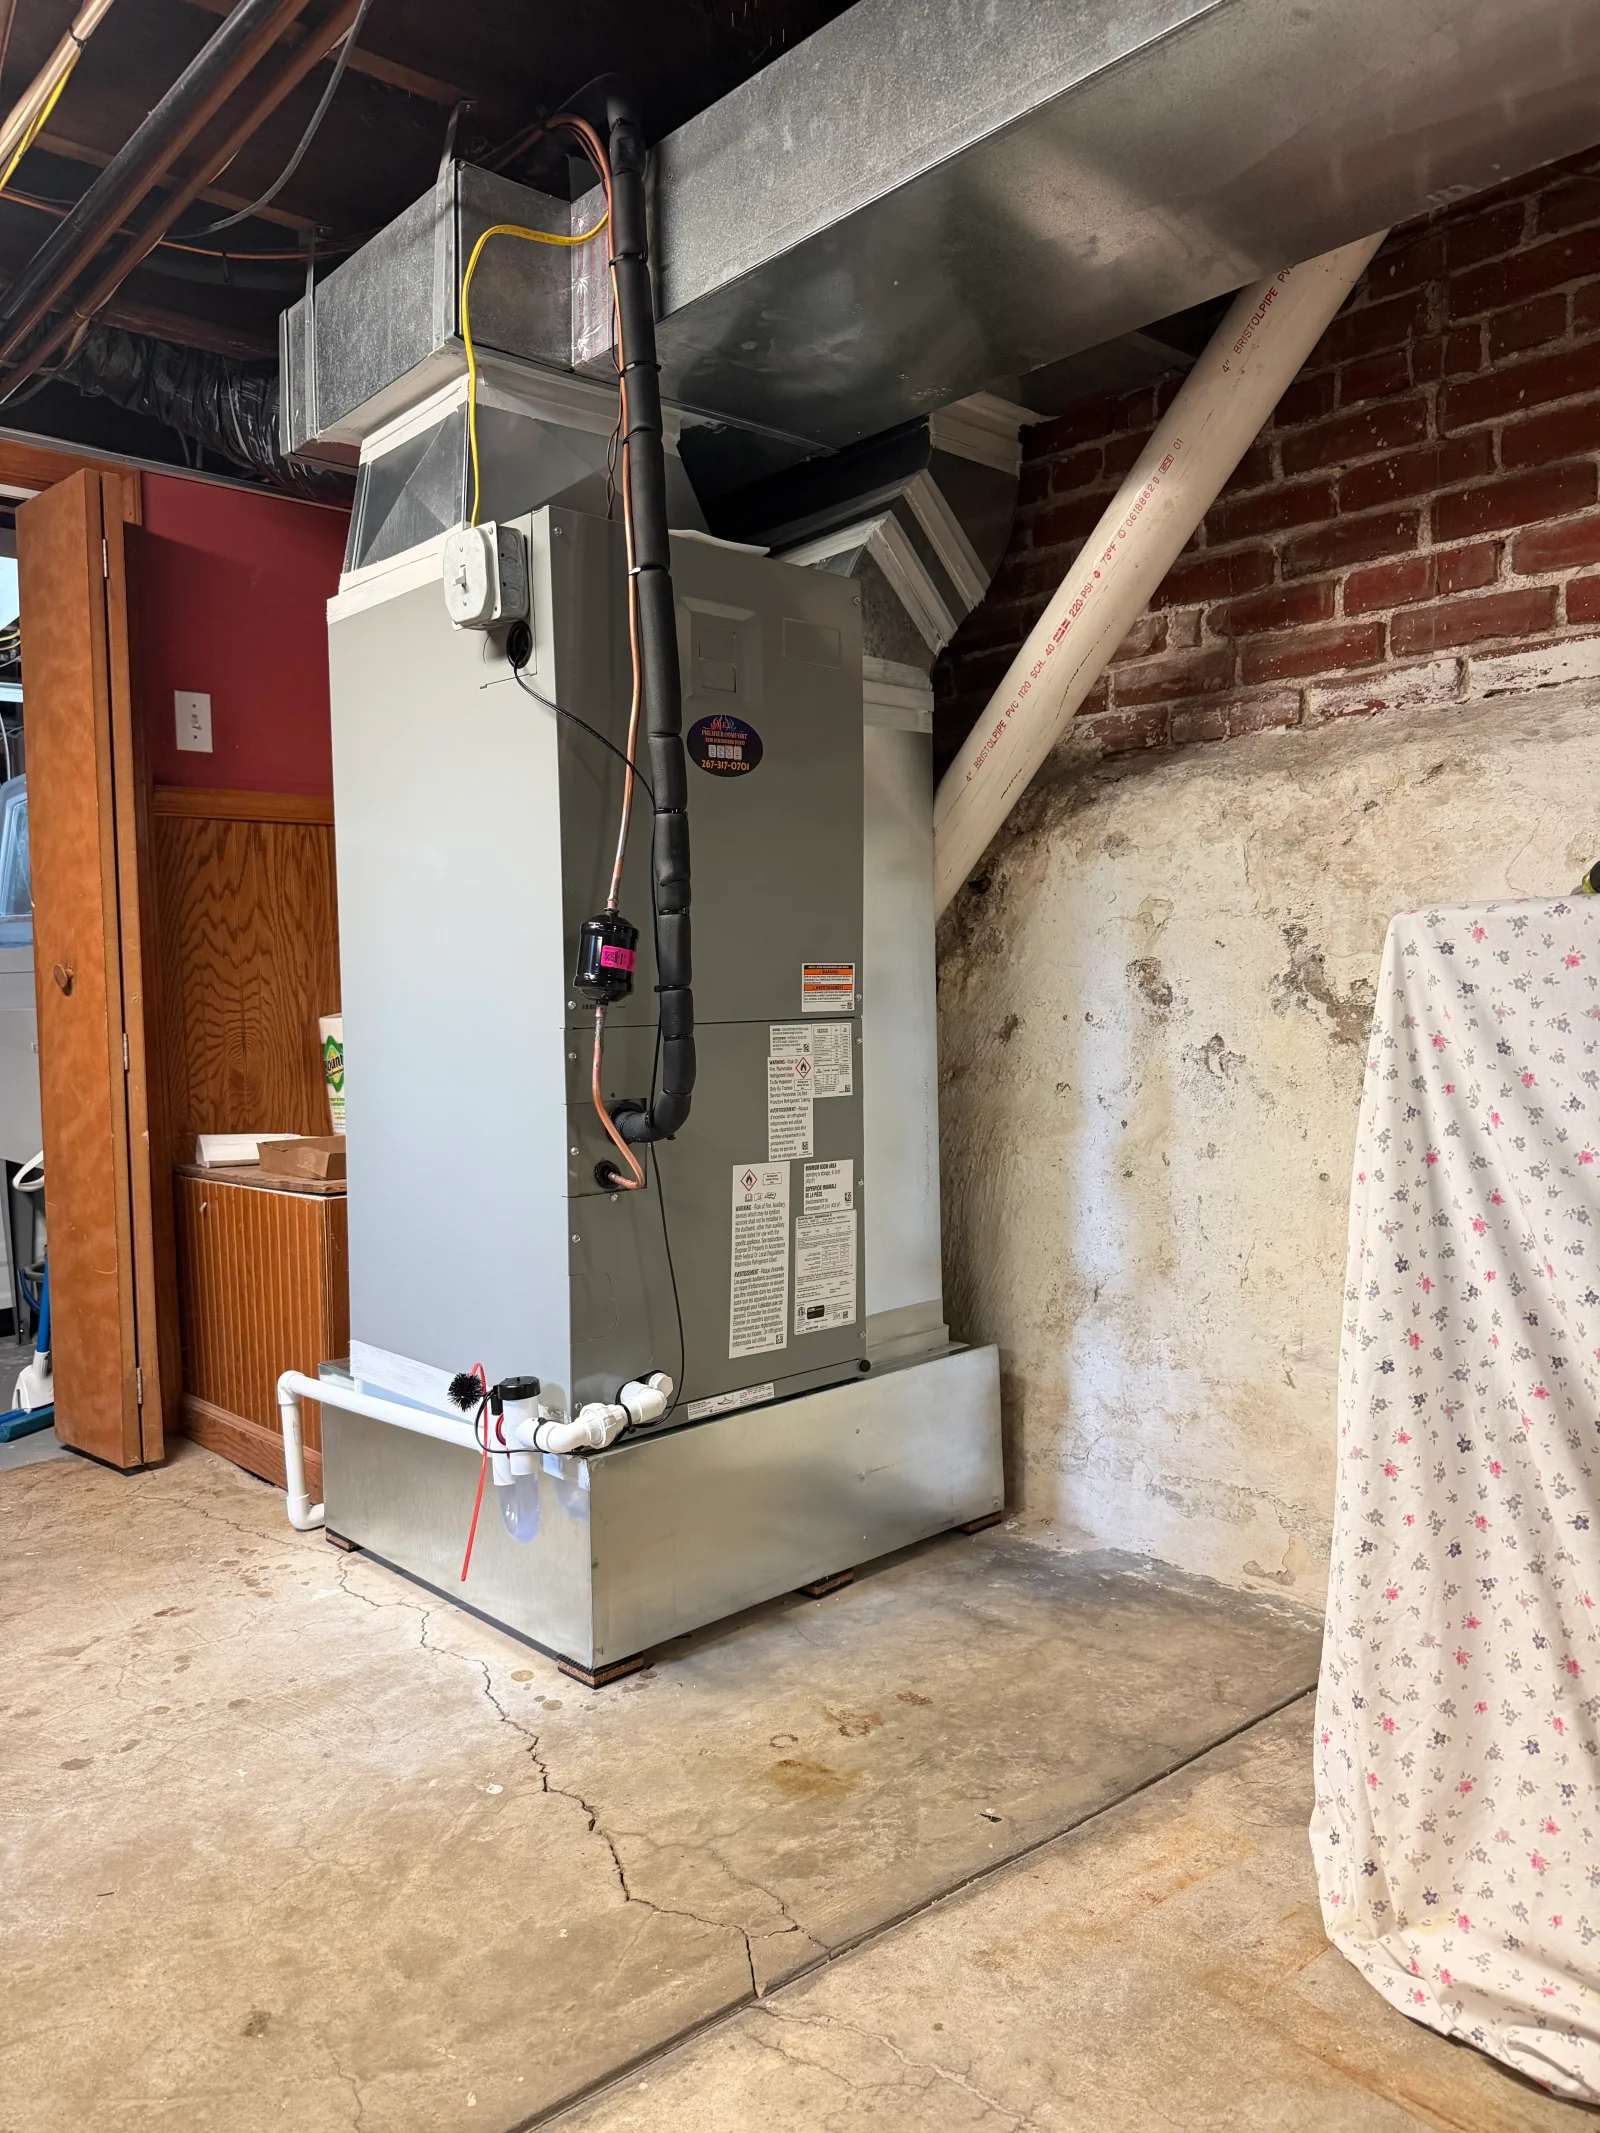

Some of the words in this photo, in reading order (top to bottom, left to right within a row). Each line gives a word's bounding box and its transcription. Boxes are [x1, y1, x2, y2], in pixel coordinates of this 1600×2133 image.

[1233, 286, 1279, 355] BRISTOLPIPE
[973, 719, 1007, 770] BRISTOLPIPE
[1005, 700, 1020, 718] PVC
[1018, 680, 1032, 699] 1120
[1030, 660, 1046, 679] SCH.
[1045, 643, 1055, 656] 40
[1068, 599, 1084, 618] 220
[701, 759, 750, 771] 267-317-0701
